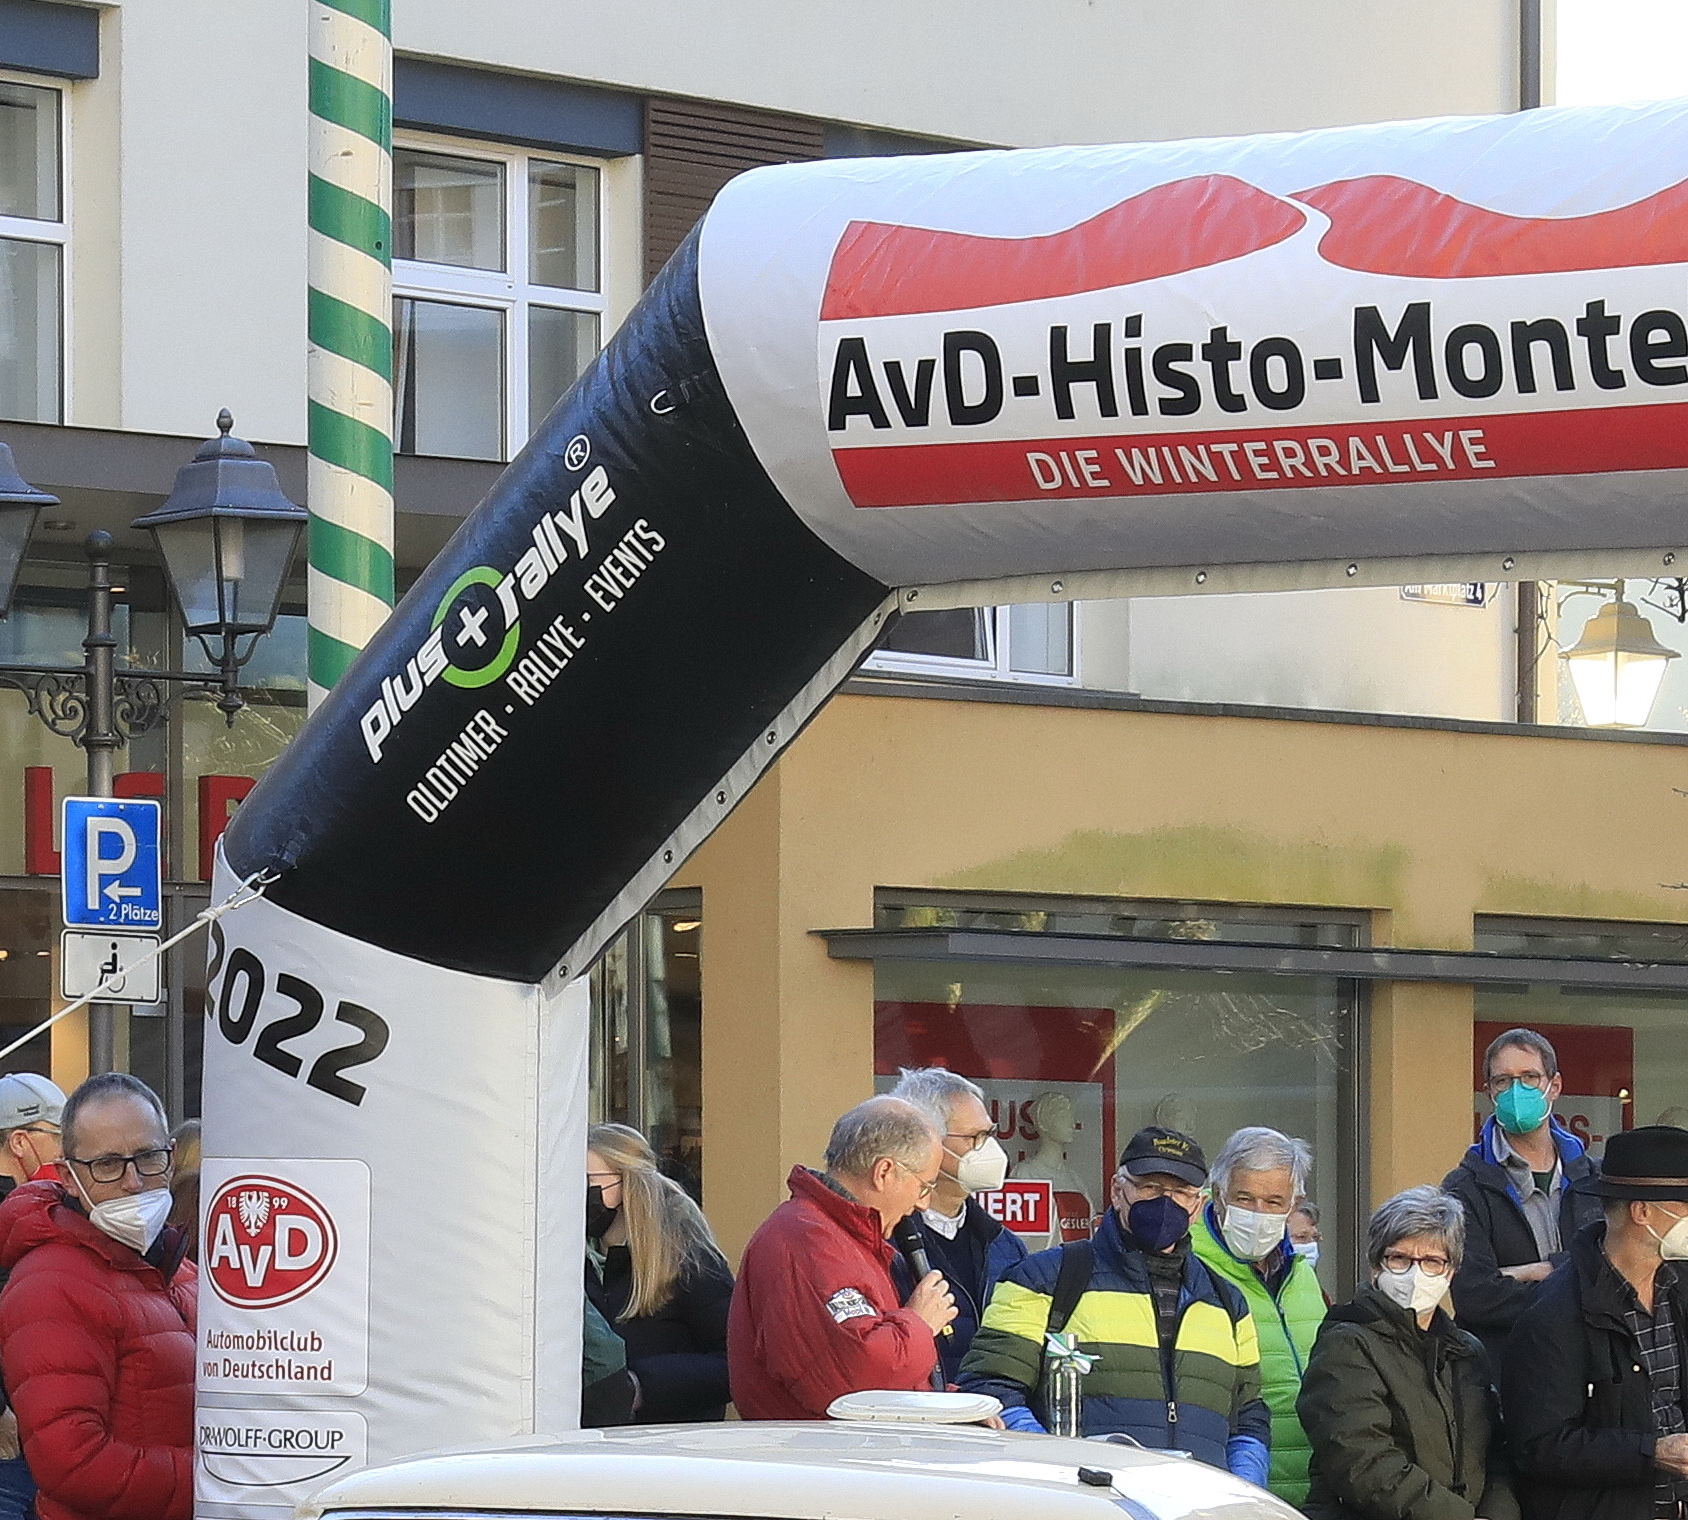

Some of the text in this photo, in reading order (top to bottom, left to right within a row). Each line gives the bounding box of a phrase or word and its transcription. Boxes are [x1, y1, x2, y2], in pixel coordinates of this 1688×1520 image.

[1026, 429, 1496, 493] DIE WINTERRALLYE
[407, 518, 665, 823] OLDTIMER RALLYE EVENTS
[88, 816, 136, 910] P
[109, 903, 117, 920] 2
[209, 917, 391, 1108] 022
[202, 1358, 334, 1382] von Deutschland
[206, 1328, 324, 1354] Automobilclub
